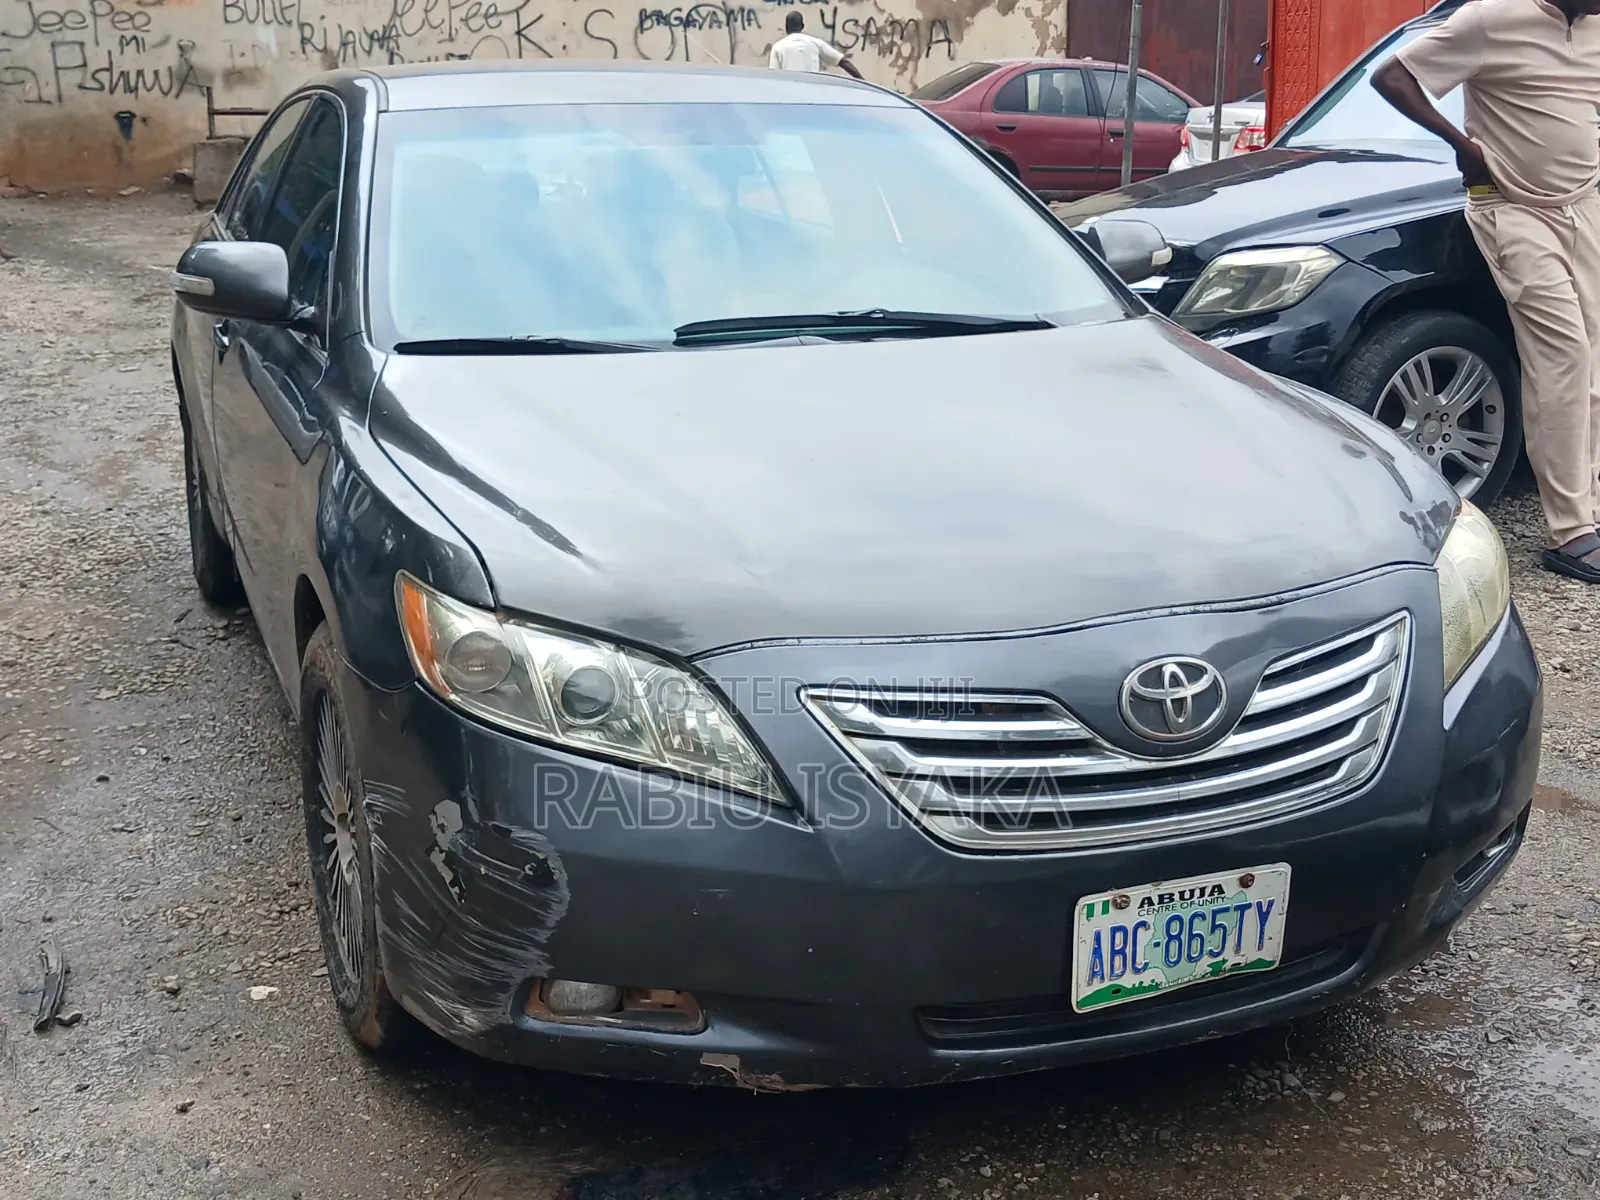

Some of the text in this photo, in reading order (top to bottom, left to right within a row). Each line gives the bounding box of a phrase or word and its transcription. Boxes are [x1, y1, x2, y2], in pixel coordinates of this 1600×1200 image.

[1137, 883, 1226, 909] ABUJA
[1137, 904, 1178, 917] CENTRE
[1196, 895, 1227, 908] UNITY
[1087, 898, 1275, 985] ABC-865TY
